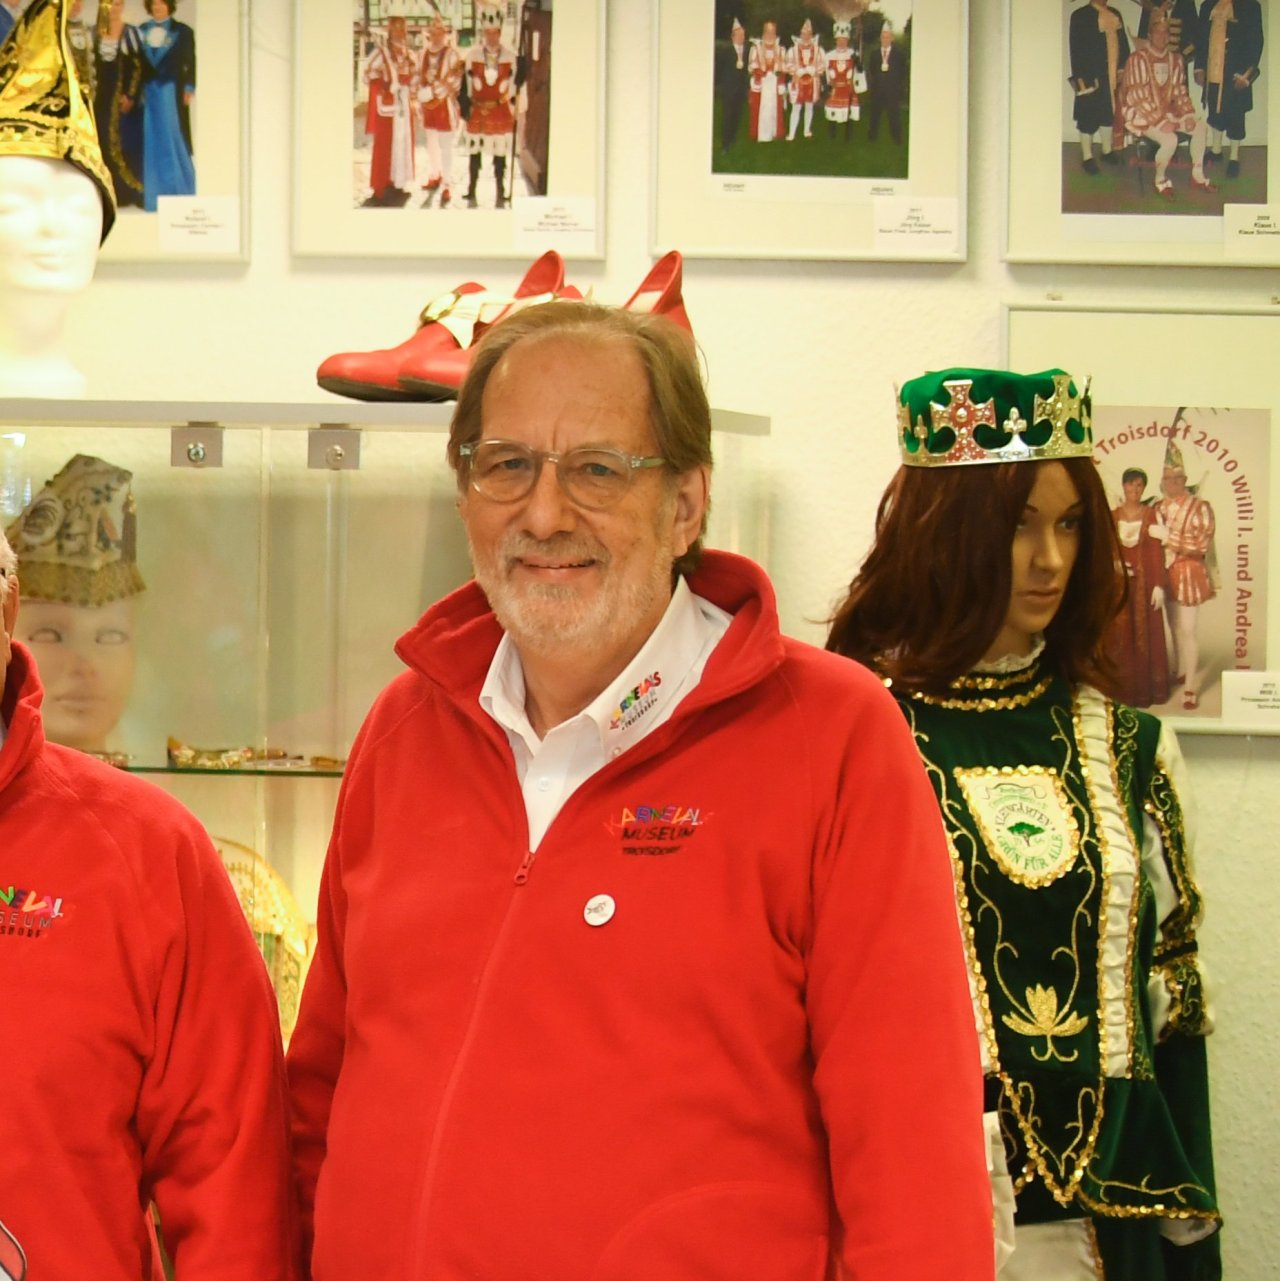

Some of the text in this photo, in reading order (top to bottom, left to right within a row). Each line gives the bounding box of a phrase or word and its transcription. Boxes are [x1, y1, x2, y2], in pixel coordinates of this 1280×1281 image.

[1095, 421, 1192, 455] Troisdorf
[1193, 430, 1239, 474] 2010
[1230, 474, 1254, 522] Willi
[1236, 543, 1253, 581] und
[1235, 586, 1253, 660] Andrea
[623, 825, 697, 841] MUSEUM
